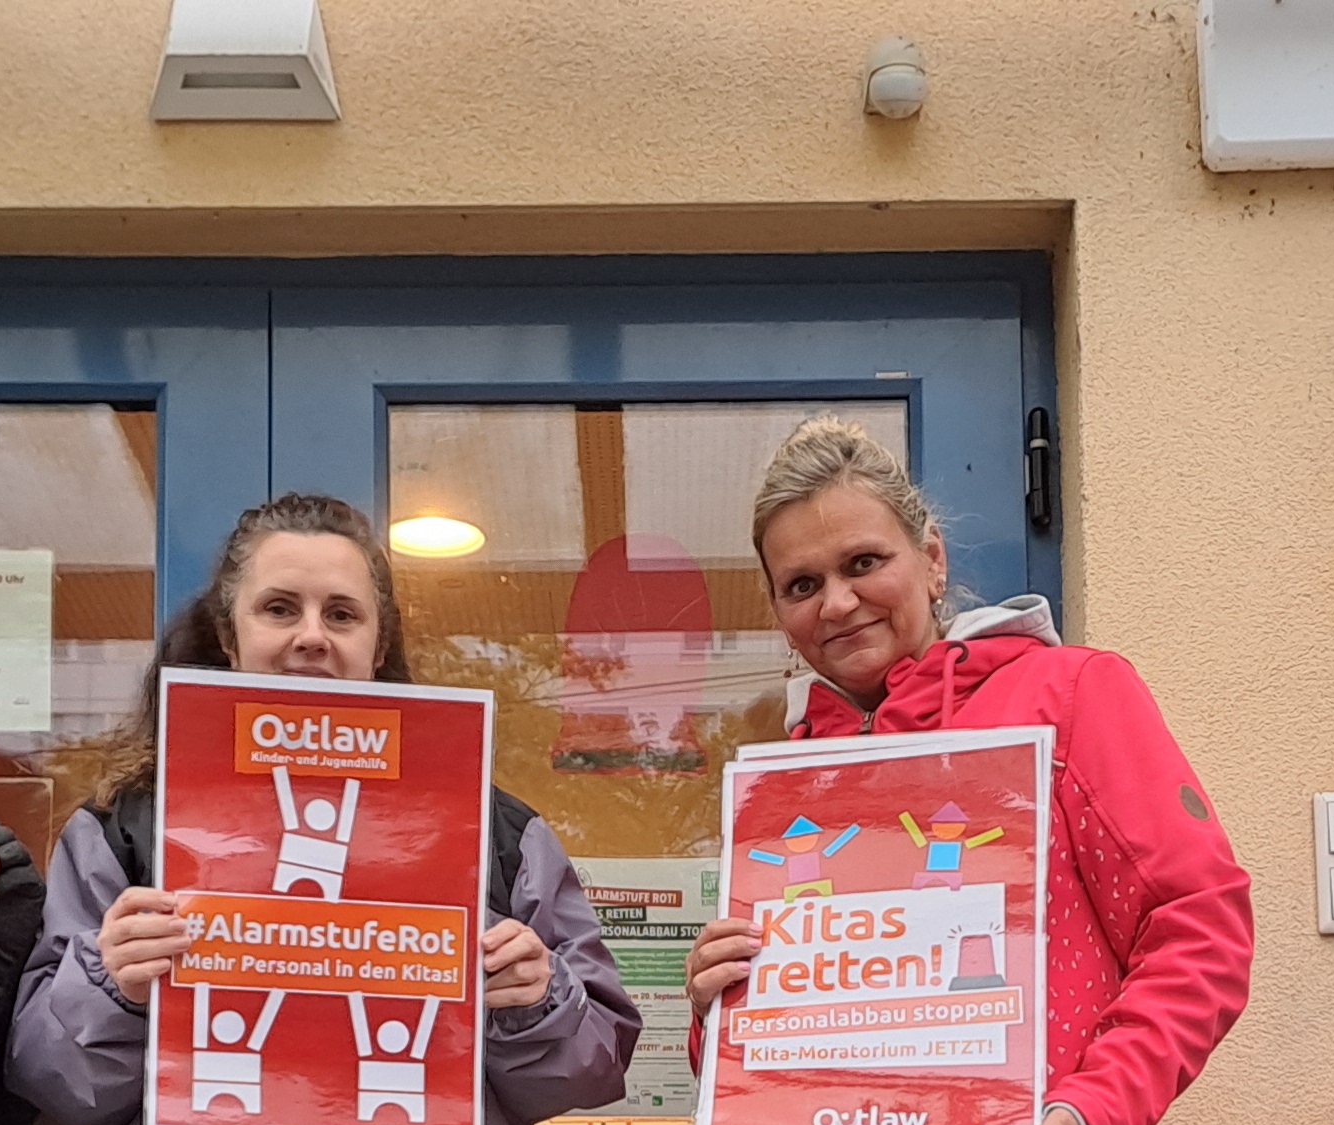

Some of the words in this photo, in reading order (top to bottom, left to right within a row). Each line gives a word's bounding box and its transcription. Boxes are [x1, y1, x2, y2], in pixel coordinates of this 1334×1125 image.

[5, 574, 24, 583] Uhr
[252, 713, 389, 754] Outlaw
[251, 750, 294, 764] Kinder-
[296, 754, 317, 766] und
[319, 756, 388, 770] Jugendhilfe
[652, 892, 676, 904] ROT!
[606, 907, 643, 919] RETTEN
[761, 901, 907, 947] Kitas
[186, 912, 457, 956] #AlarmstufeRot
[600, 925, 678, 938] RSONALABBAU
[181, 952, 237, 971] Mehr
[241, 955, 331, 977] Personal
[334, 958, 354, 977] in
[358, 960, 397, 980] den
[401, 963, 459, 984] Kitas!
[756, 944, 943, 994] retten!
[736, 1006, 906, 1034] Personalabbau
[912, 996, 1015, 1023] stoppen!
[750, 1041, 917, 1062] Kita-Moratorium
[923, 1039, 993, 1056] JETZT!
